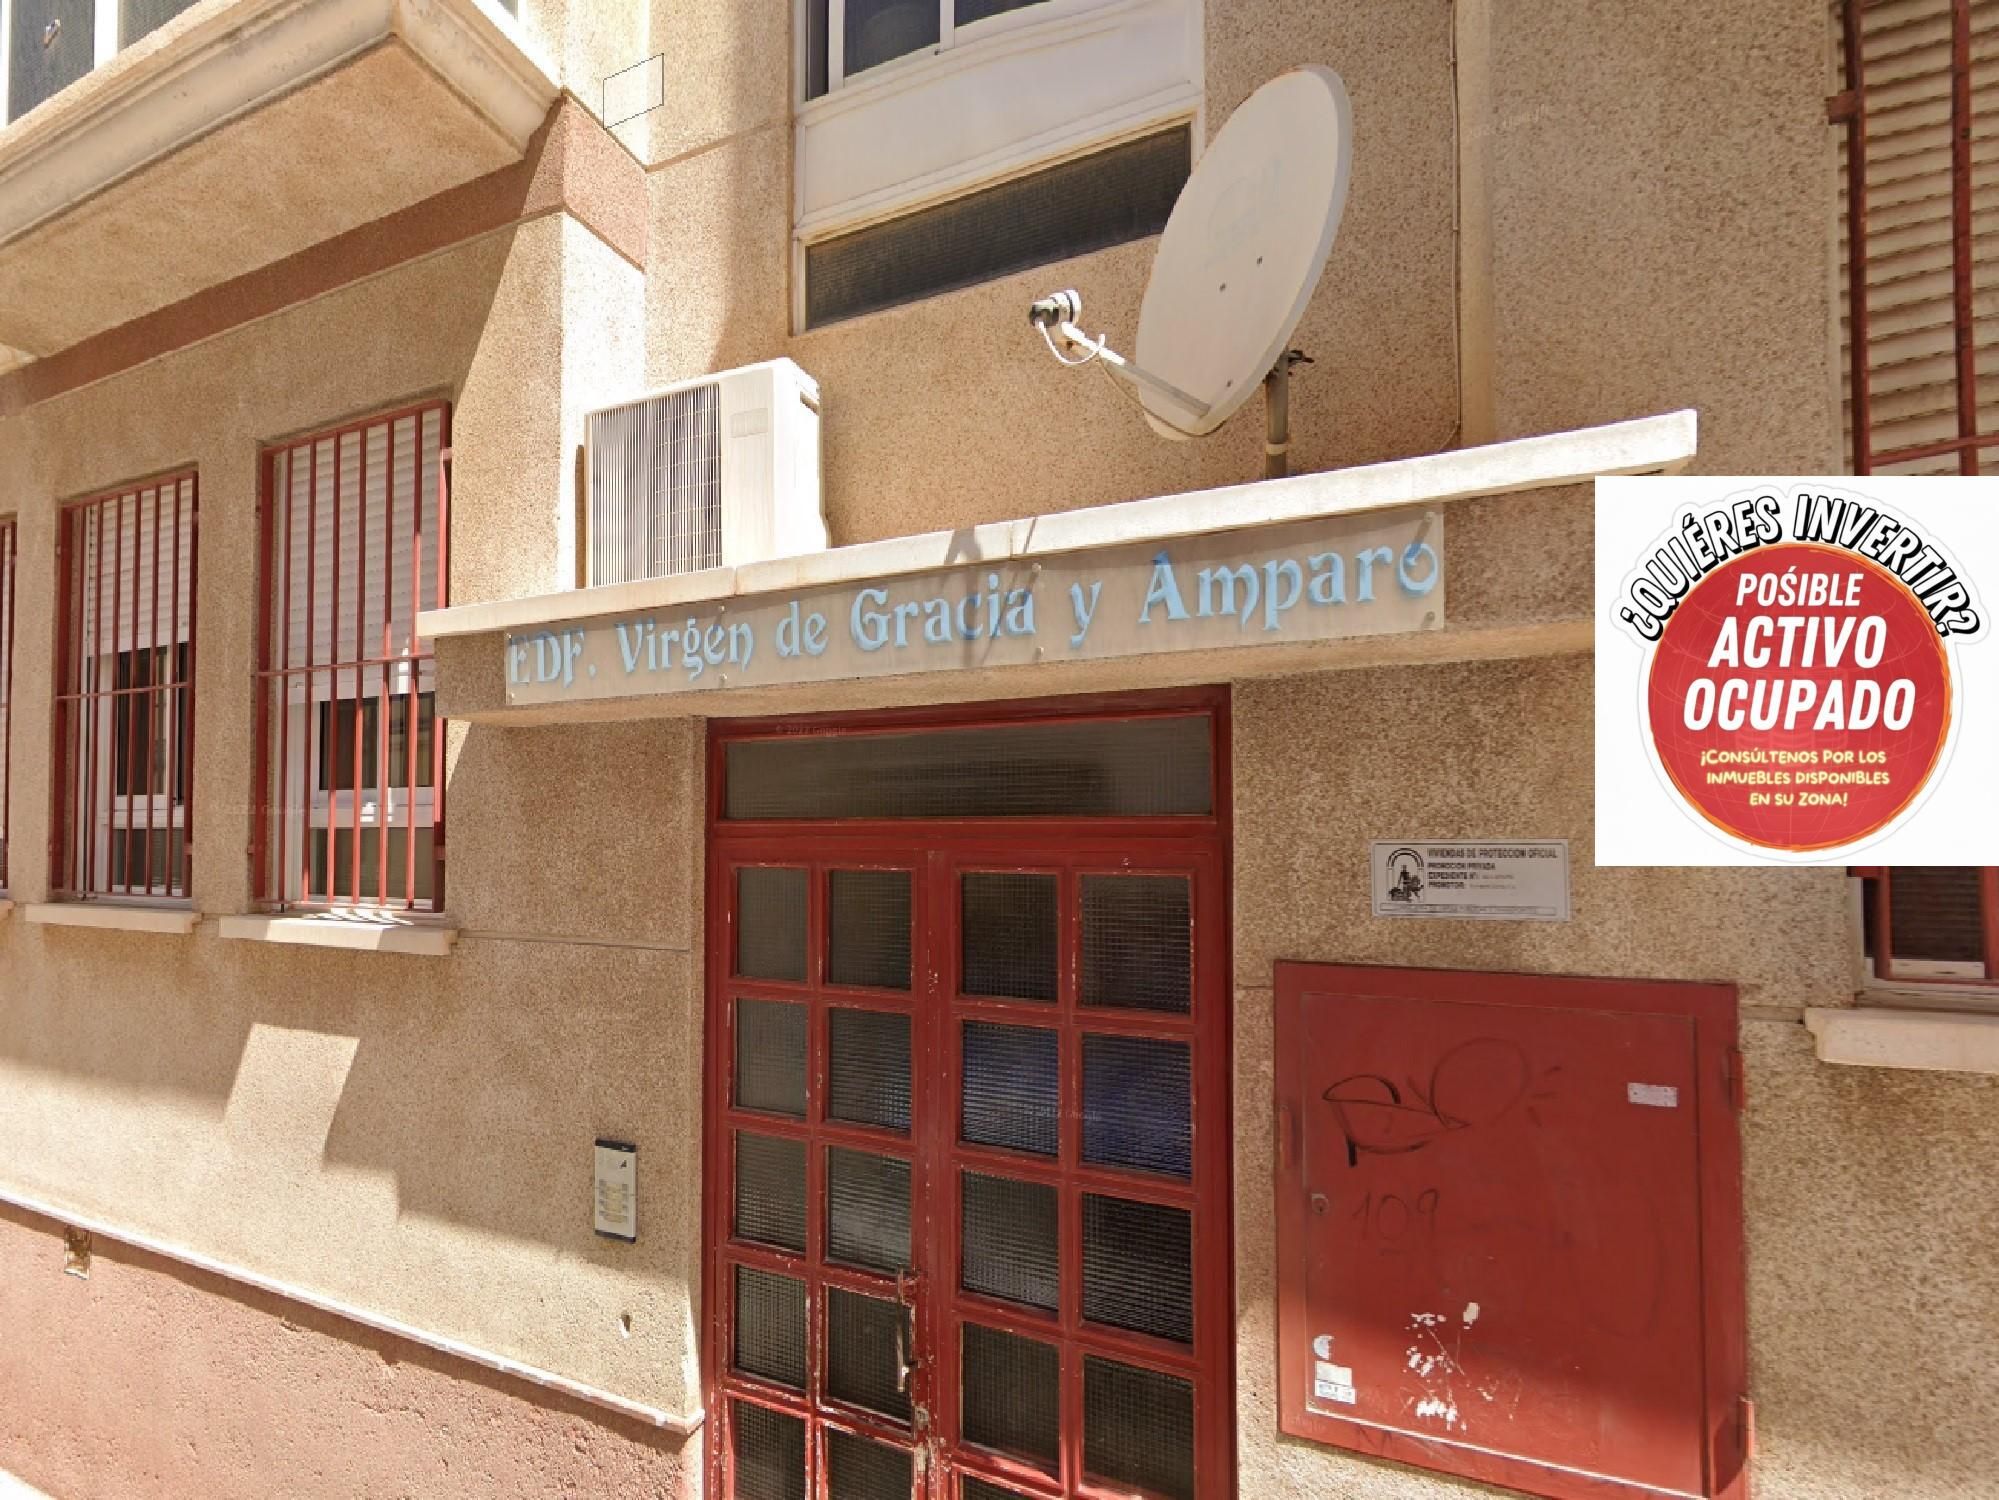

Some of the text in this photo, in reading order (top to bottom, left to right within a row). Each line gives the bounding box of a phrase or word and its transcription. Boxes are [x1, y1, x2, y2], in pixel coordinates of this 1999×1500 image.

[615, 616, 754, 682] Virgen
[775, 601, 829, 657] de
[850, 572, 1037, 652] Gracia
[1068, 580, 1102, 648] y
